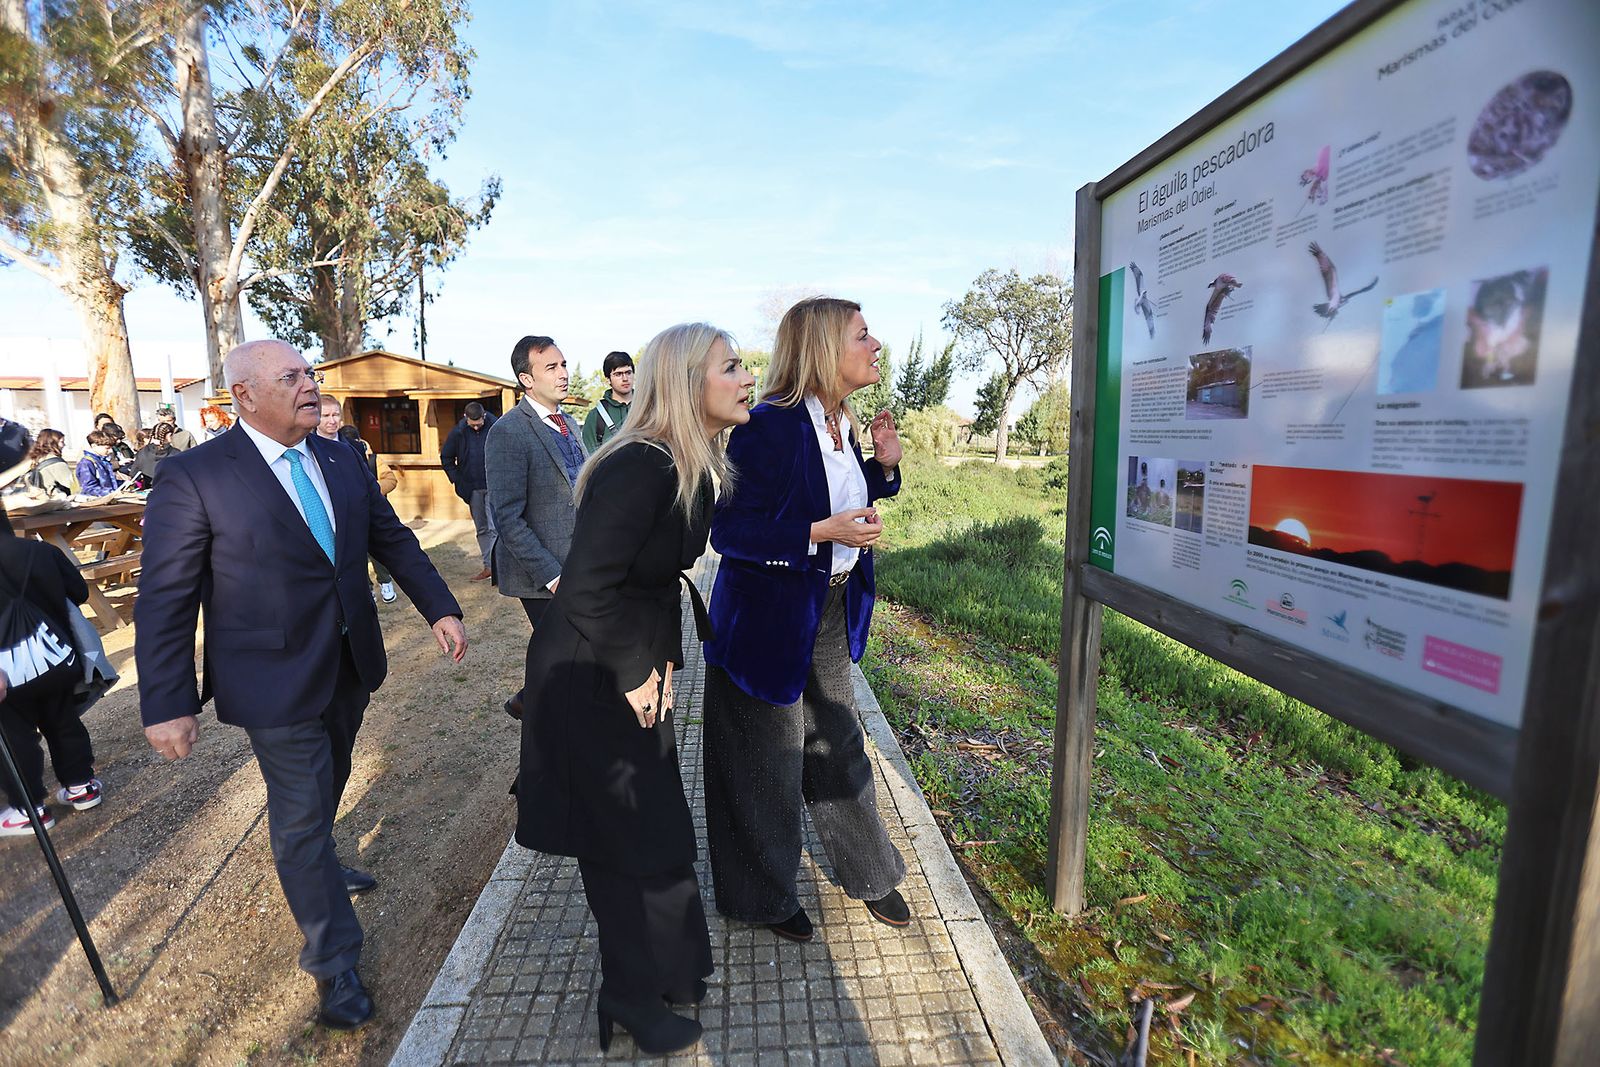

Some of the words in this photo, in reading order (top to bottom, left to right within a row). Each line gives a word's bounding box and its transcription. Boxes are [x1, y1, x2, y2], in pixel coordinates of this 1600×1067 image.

[1138, 189, 1149, 214] El
[1152, 170, 1188, 207] águila
[1192, 121, 1275, 189] pescadora
[1137, 207, 1174, 234] Marismas
[1175, 195, 1189, 215] del
[1191, 181, 1218, 207] Odiel.
